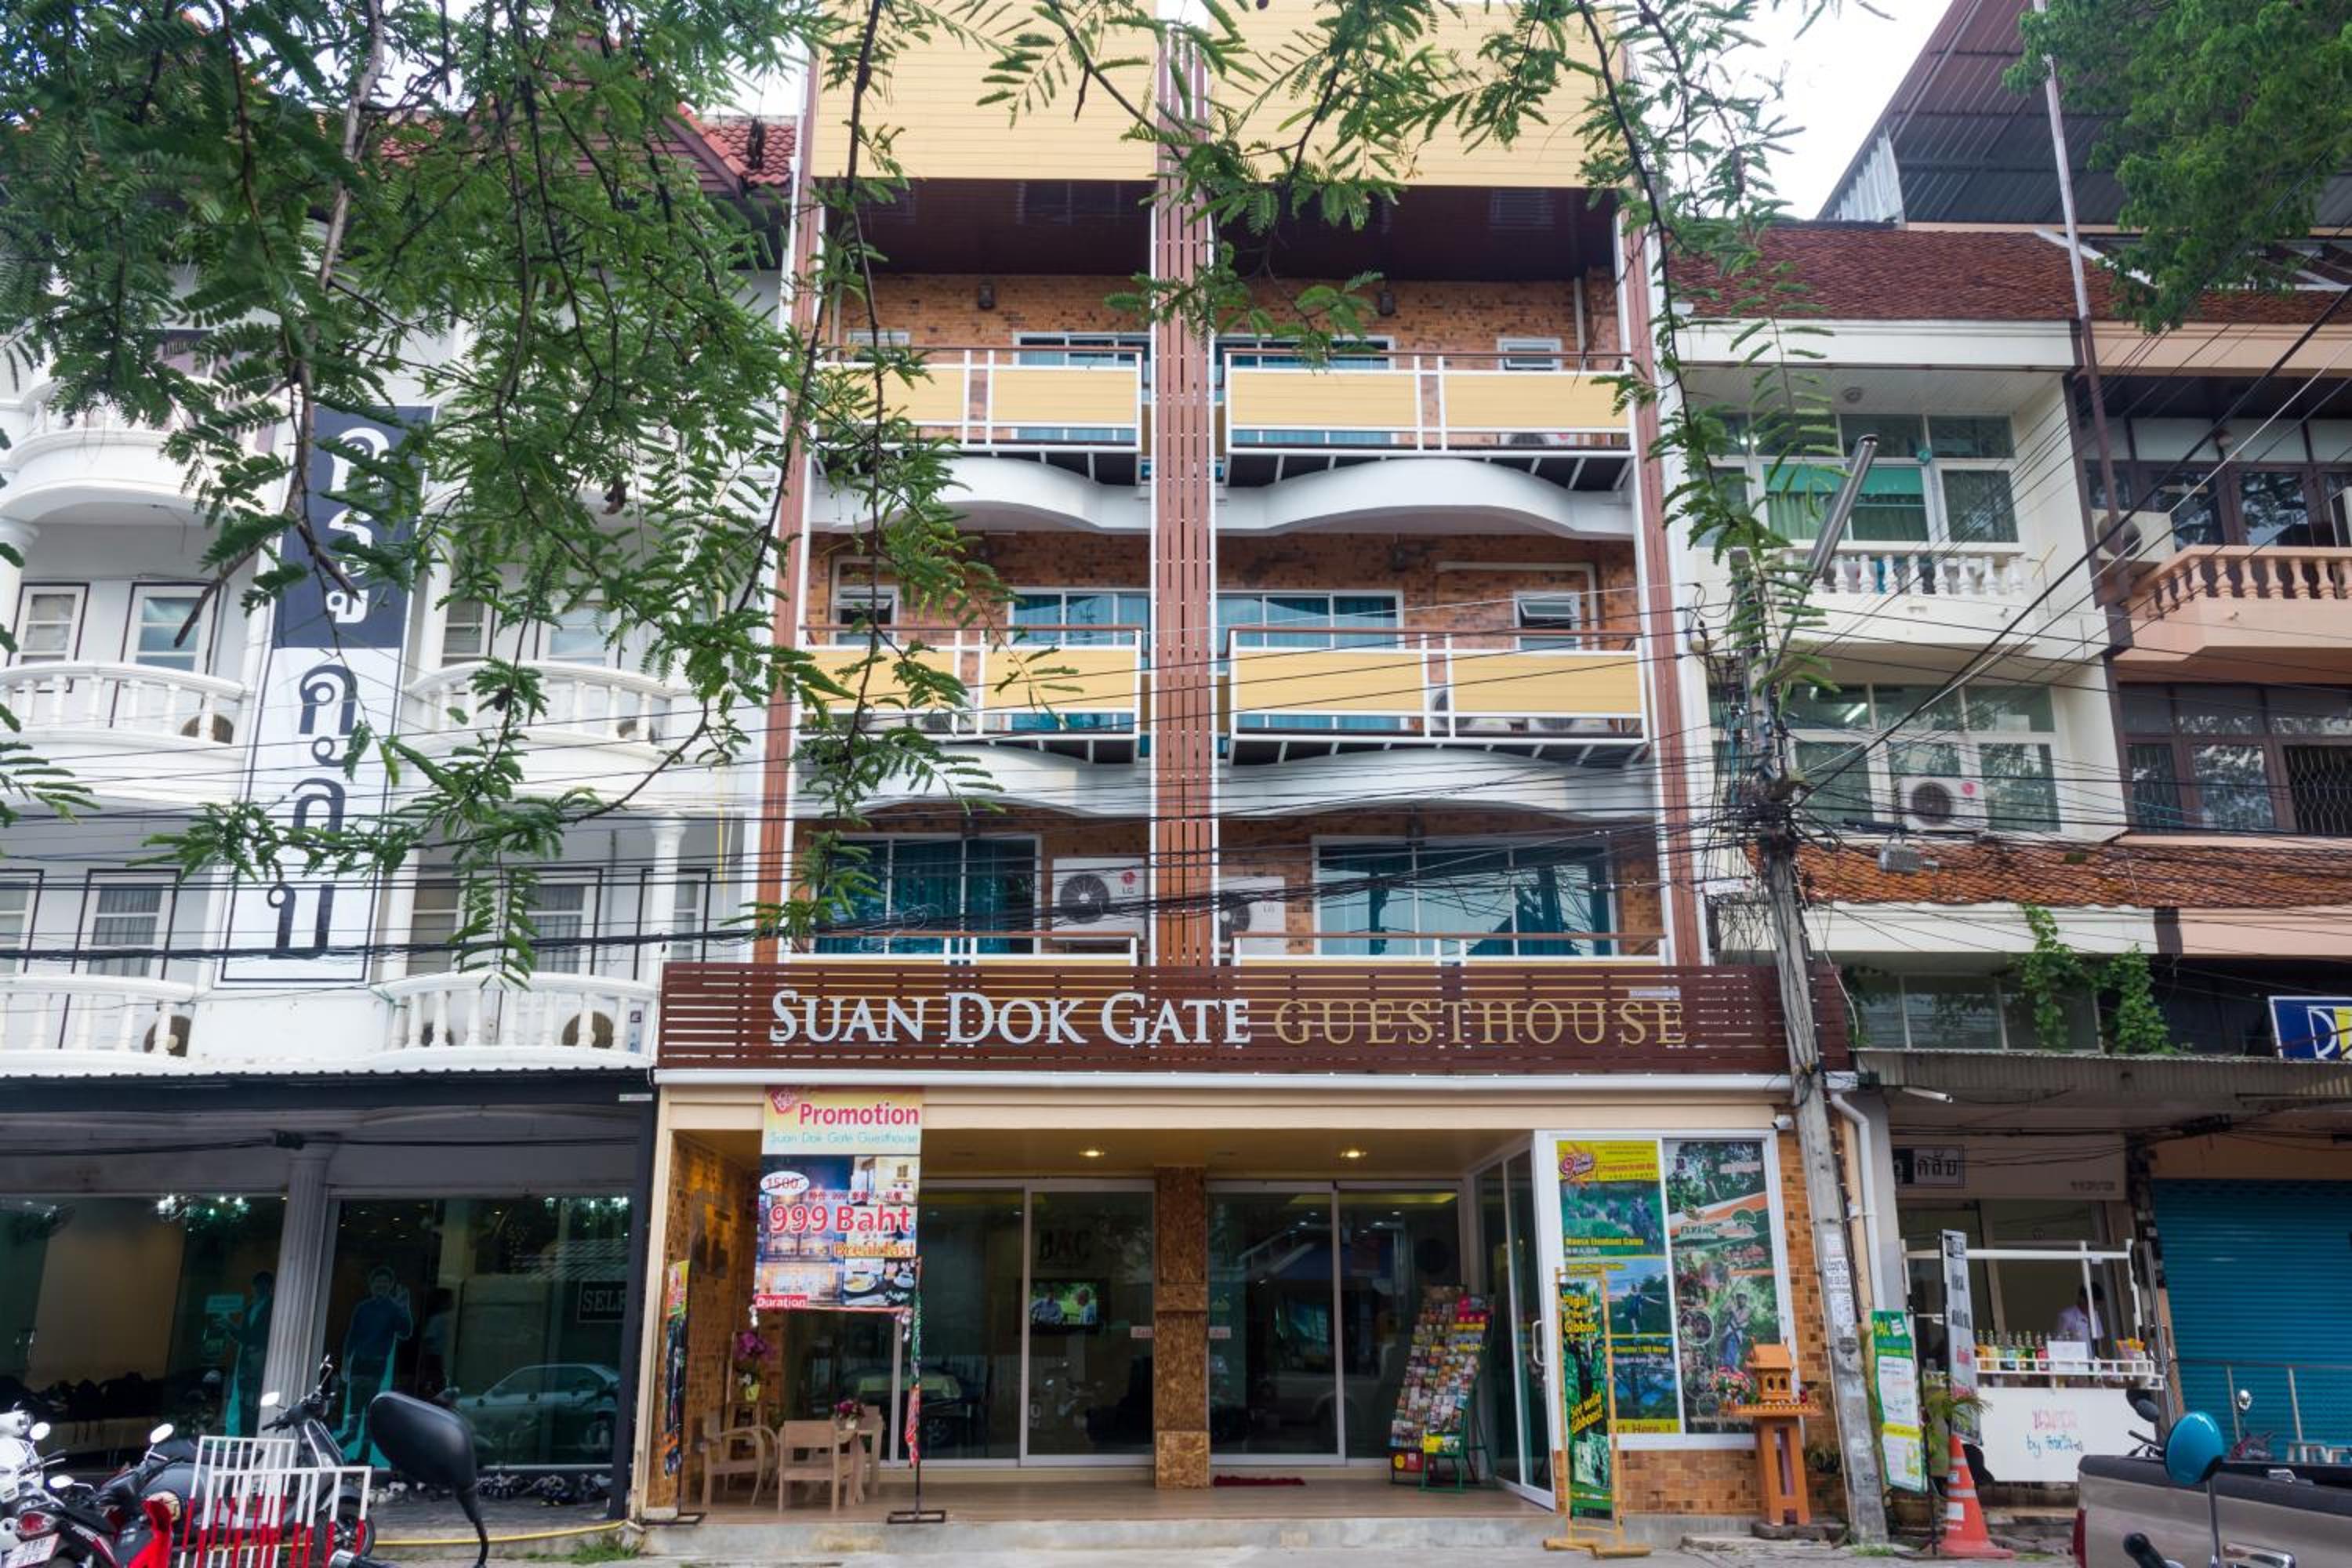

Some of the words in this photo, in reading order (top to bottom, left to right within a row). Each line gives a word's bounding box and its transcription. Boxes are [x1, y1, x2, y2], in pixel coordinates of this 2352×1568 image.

[769, 989, 928, 1043] SUAN
[945, 992, 1089, 1044] DOK
[1101, 992, 1252, 1044] GATE
[1273, 1000, 1688, 1045] GUESTHOUSE
[799, 1102, 919, 1125] Promotion
[770, 1205, 829, 1232] 999
[836, 1204, 911, 1232] Baht
[835, 1242, 915, 1256] Breakfast
[757, 1297, 806, 1308] Duration
